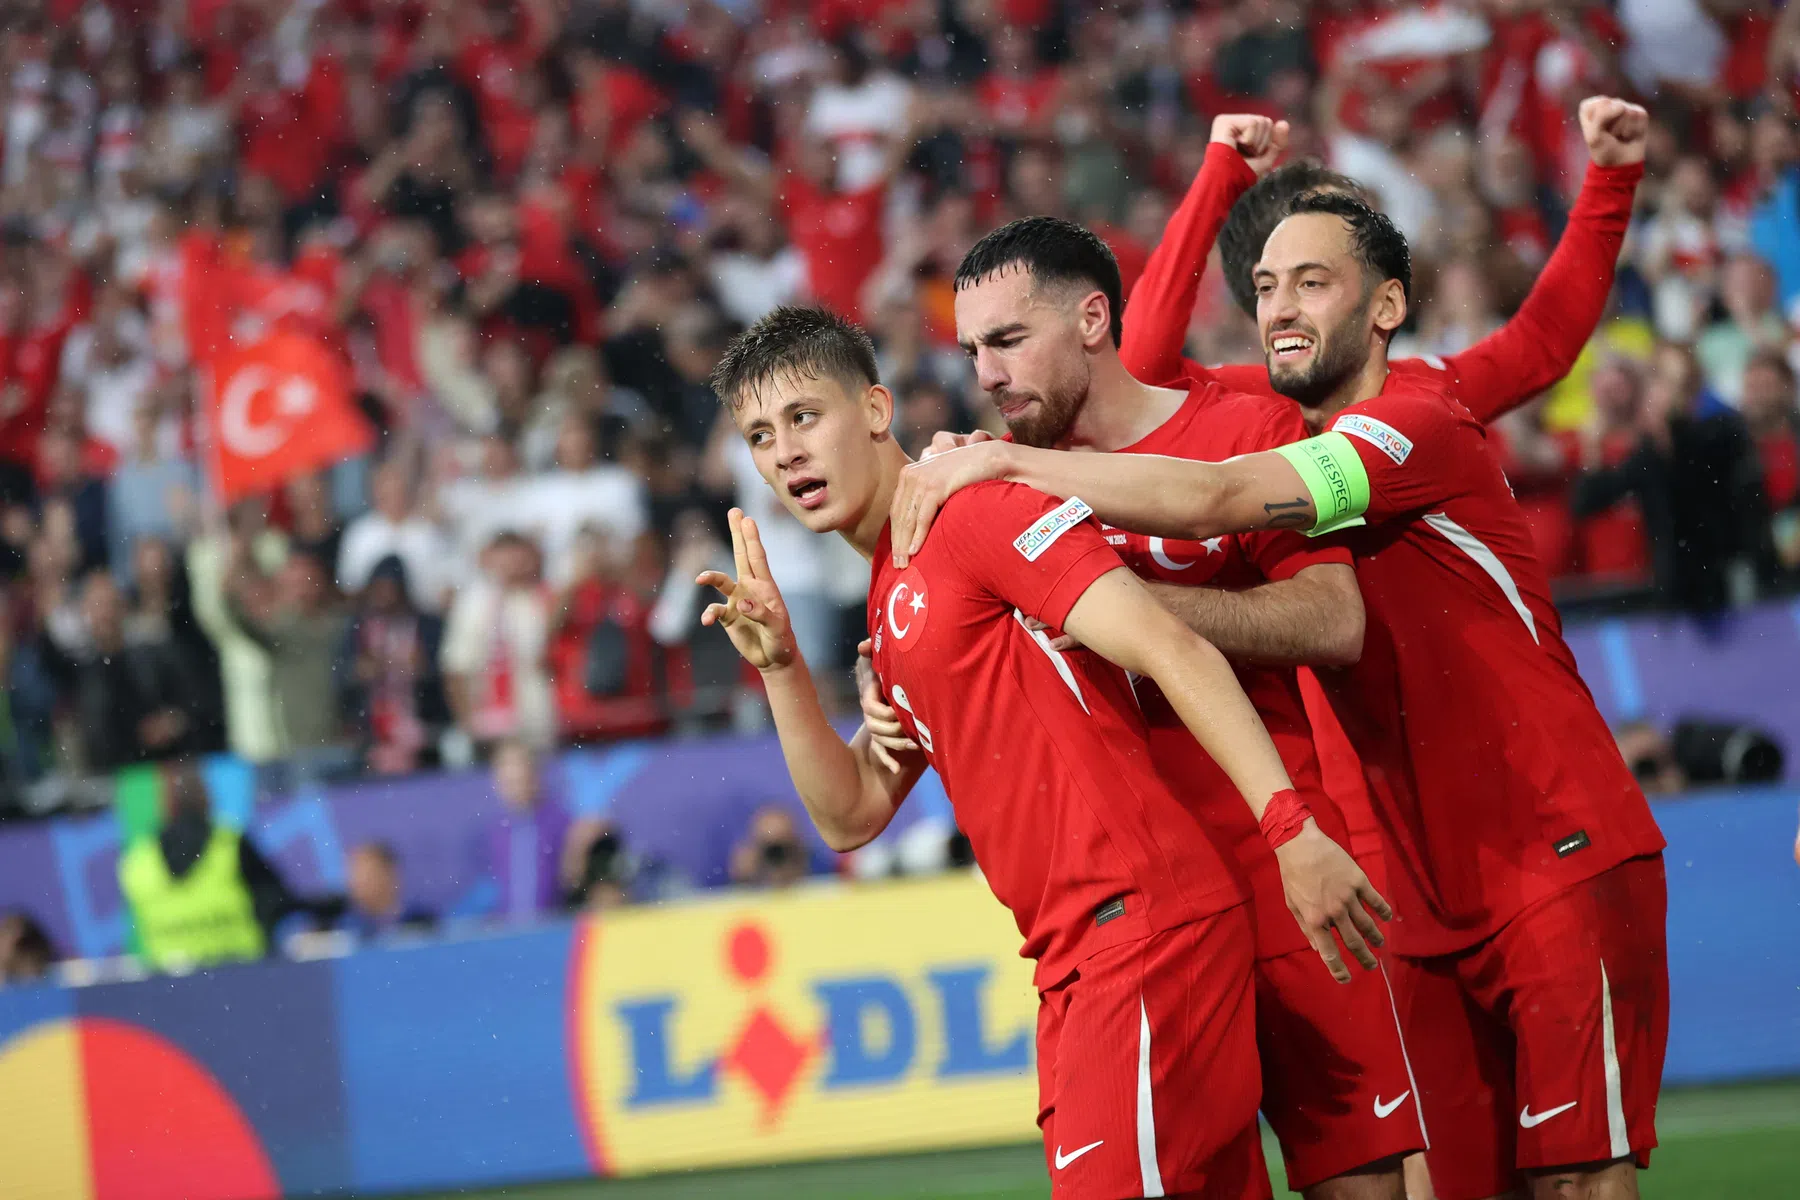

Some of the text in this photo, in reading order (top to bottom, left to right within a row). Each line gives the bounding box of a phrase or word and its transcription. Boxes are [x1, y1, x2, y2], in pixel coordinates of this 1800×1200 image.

[1337, 420, 1409, 458] FOUNDATION
[1317, 454, 1348, 513] RESPECT
[1015, 532, 1032, 548] UEFA
[1020, 501, 1086, 554] FOUNDATION
